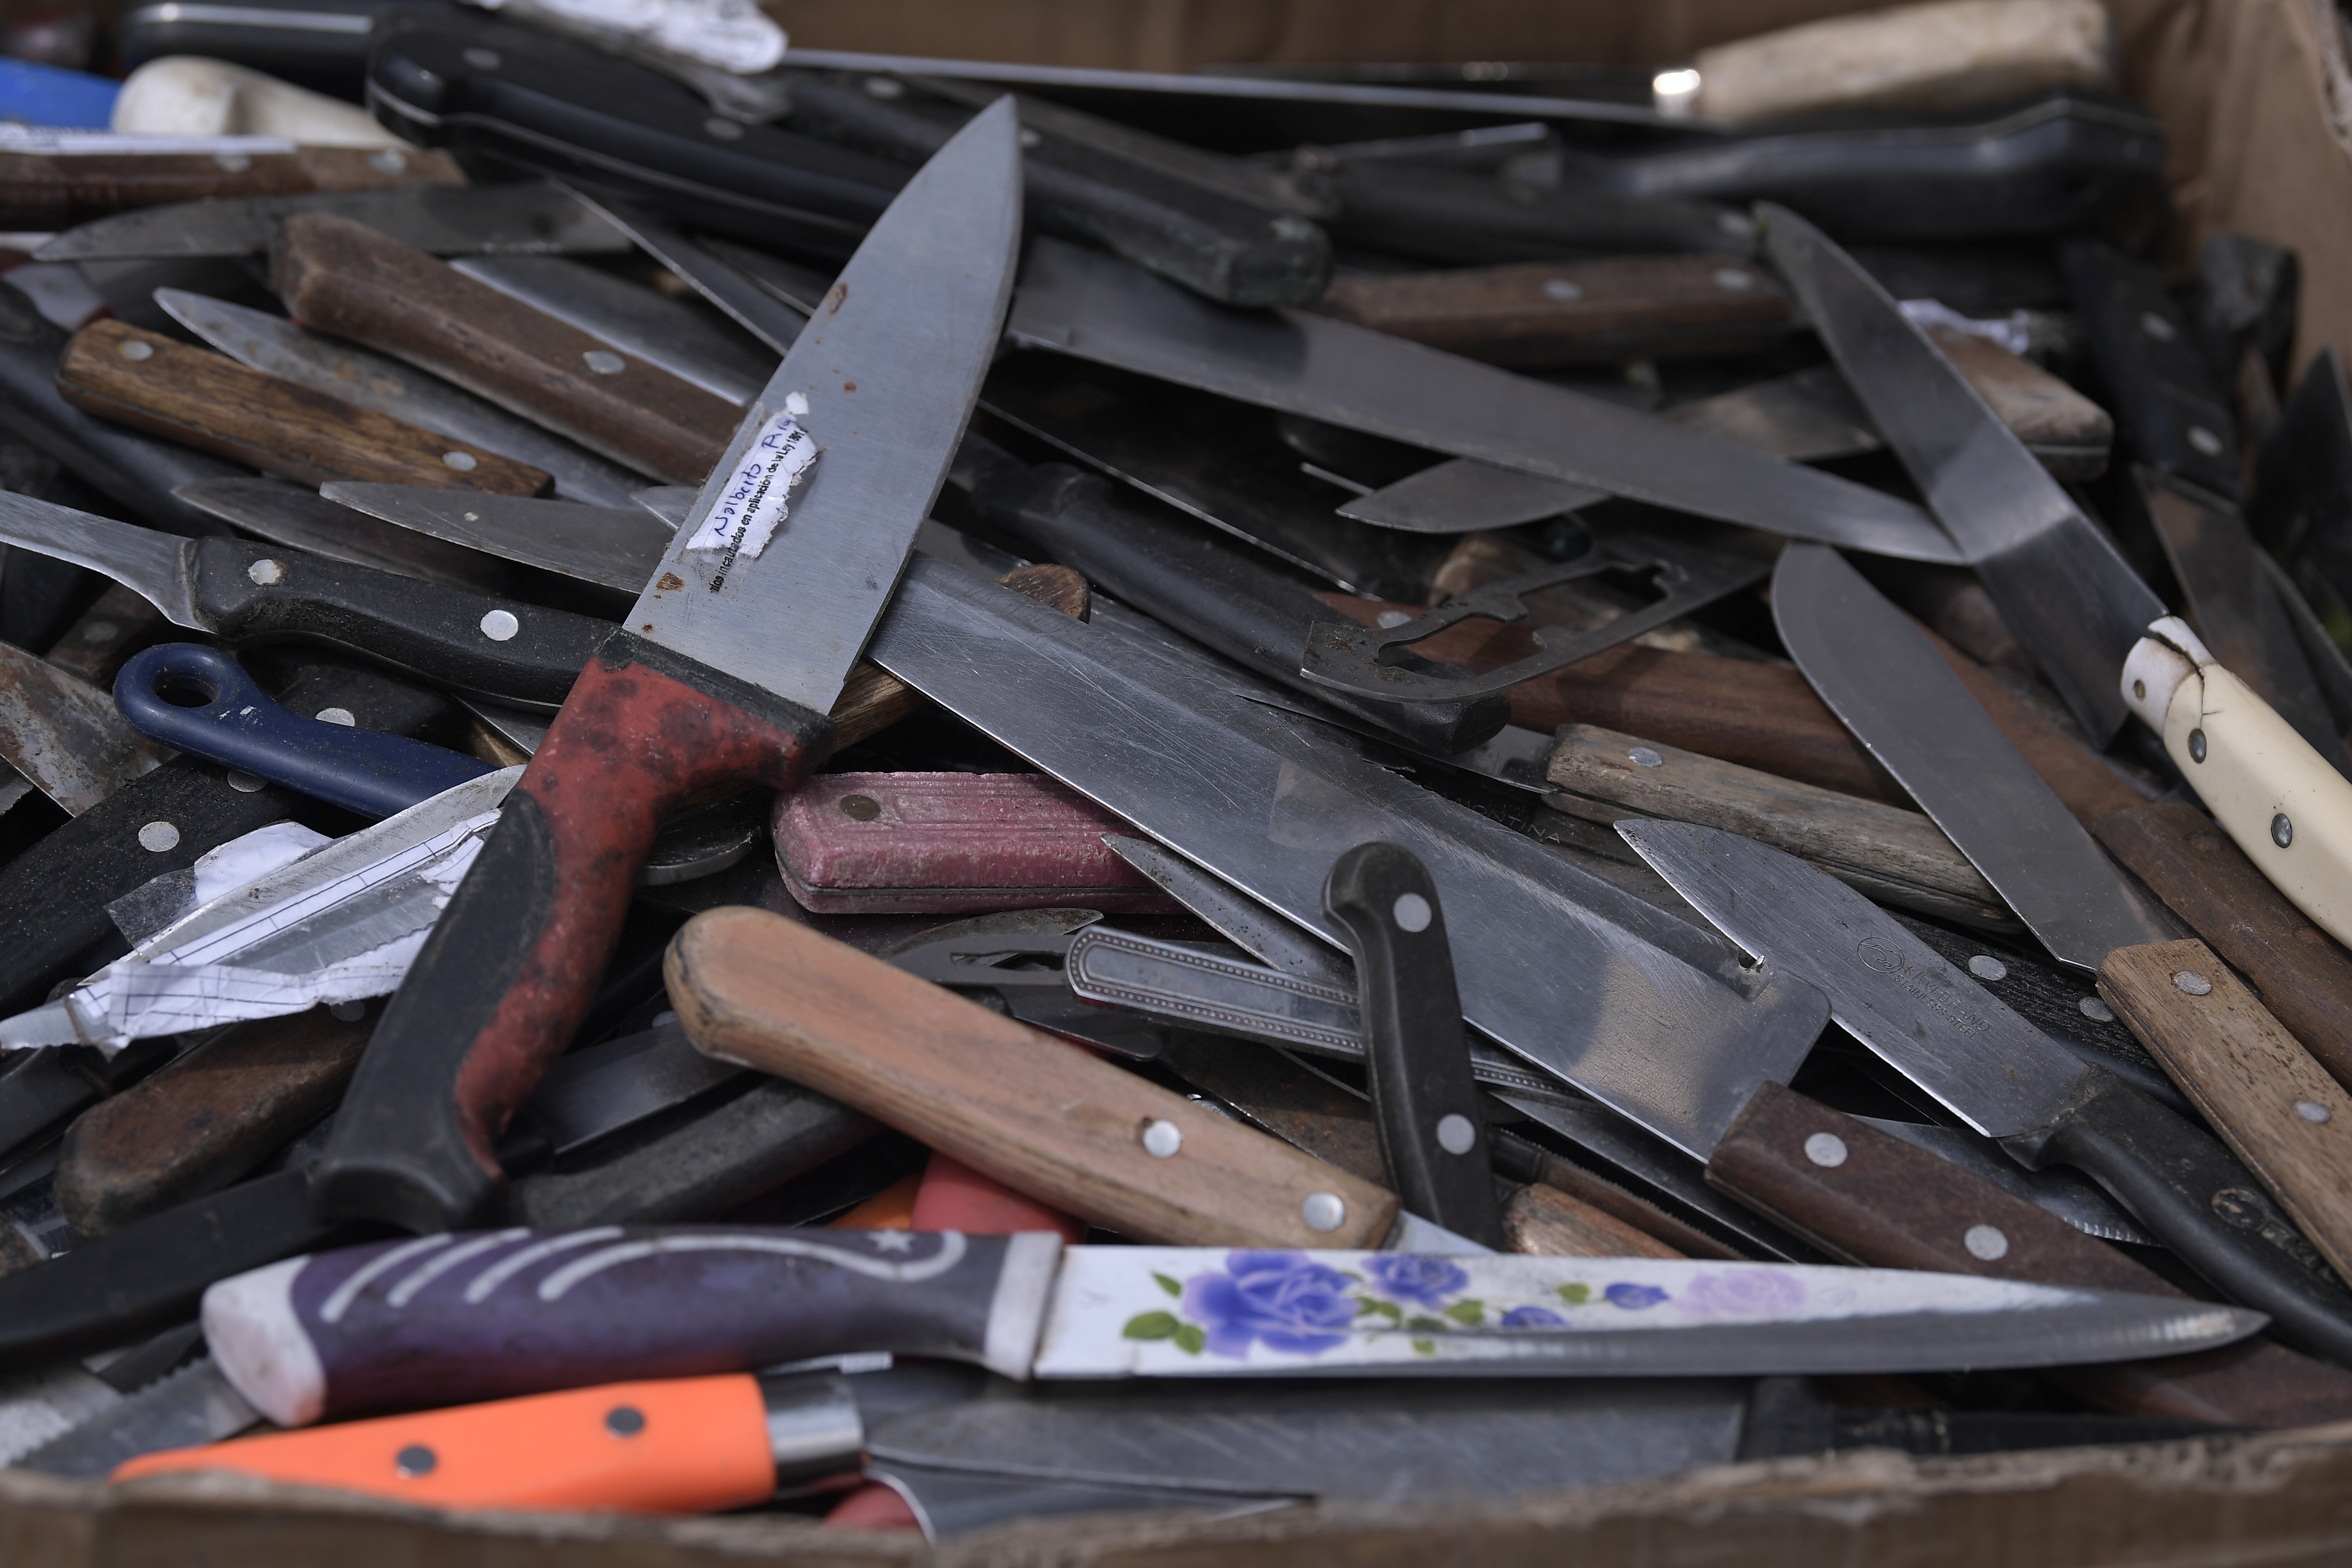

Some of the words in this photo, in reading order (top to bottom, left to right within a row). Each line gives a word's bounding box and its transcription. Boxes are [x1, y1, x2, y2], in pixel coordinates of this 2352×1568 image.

[766, 462, 779, 473] de
[776, 443, 796, 455] Ley
[746, 474, 773, 514] aplicación
[741, 514, 753, 526] en
[716, 526, 747, 576] incautados
[1417, 782, 1561, 844] MONTINA
[1894, 974, 1949, 1016] STAINLESS
[1946, 1014, 1978, 1041] STEEL
